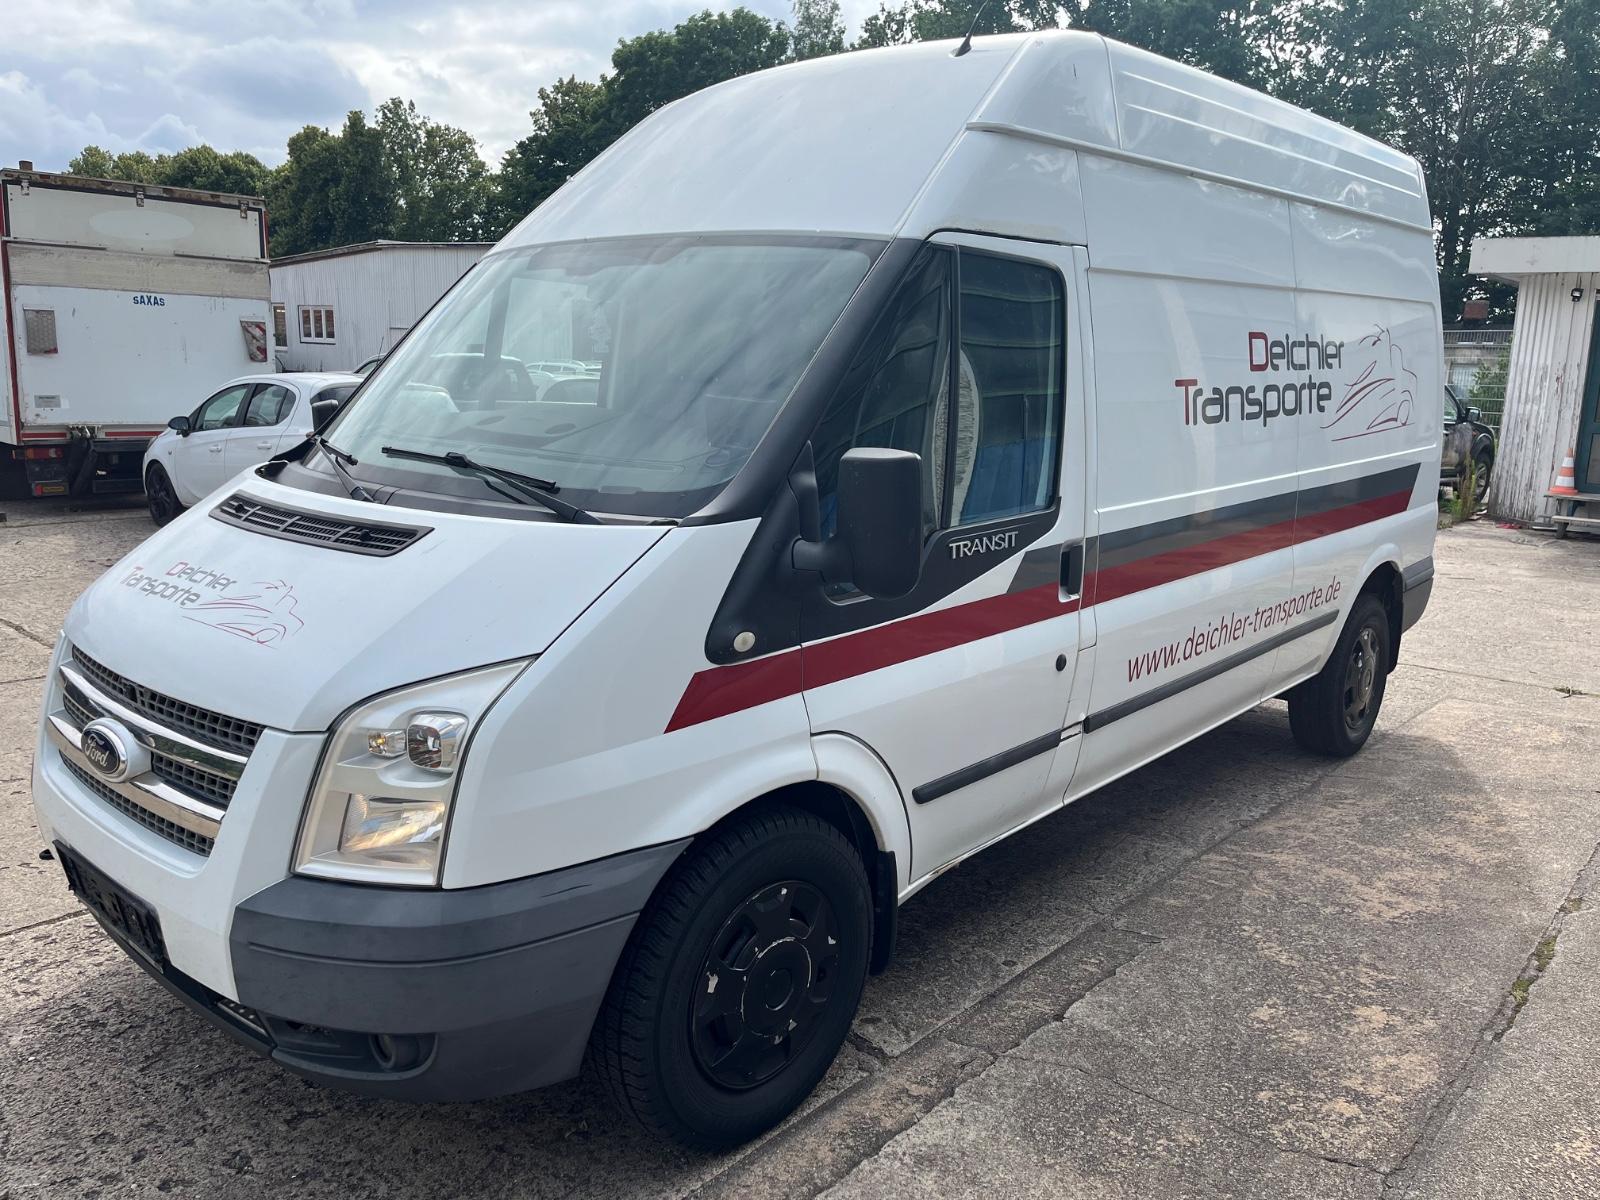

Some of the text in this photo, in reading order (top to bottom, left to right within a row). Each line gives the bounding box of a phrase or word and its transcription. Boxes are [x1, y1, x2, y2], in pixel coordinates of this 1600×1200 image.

[1248, 332, 1344, 371] Deichler
[1175, 374, 1332, 427] Transporte
[949, 531, 1018, 559] TRANSIT
[120, 566, 201, 605] Transporte
[165, 561, 237, 591] Deichler
[1128, 576, 1341, 682] www.deichler-transporte.de
[84, 733, 110, 767] Ford
